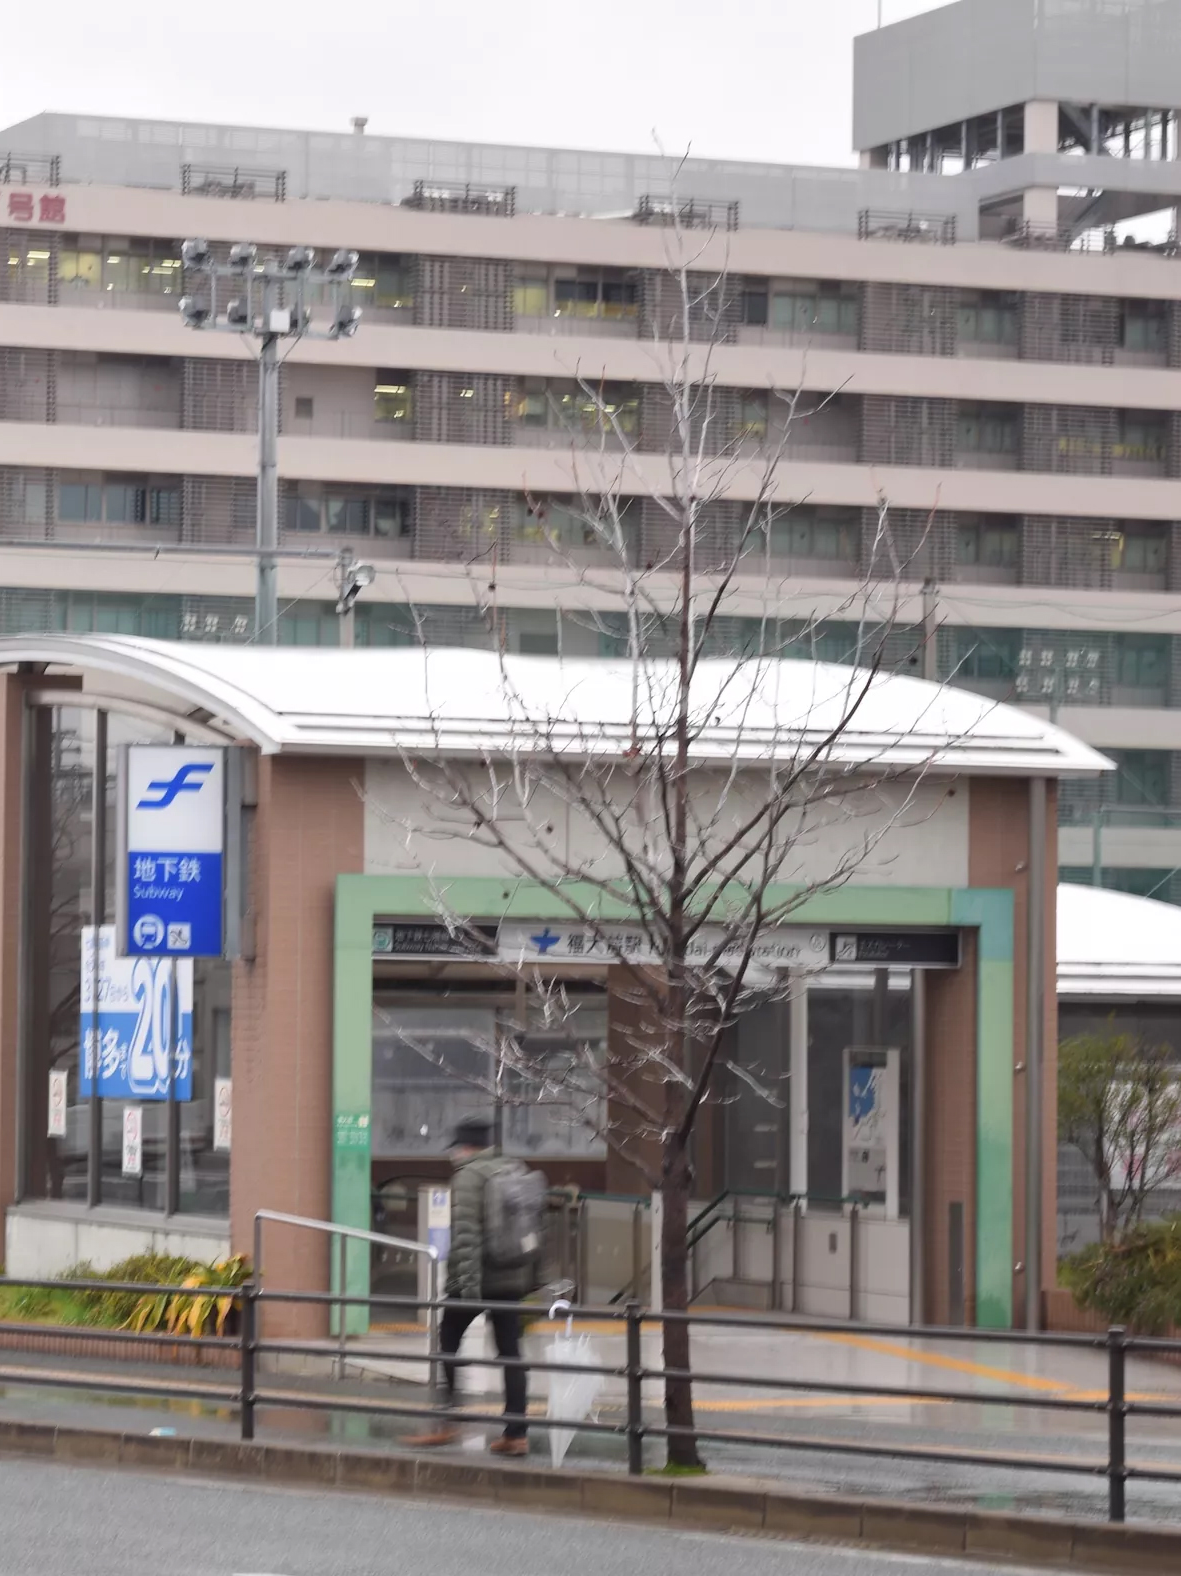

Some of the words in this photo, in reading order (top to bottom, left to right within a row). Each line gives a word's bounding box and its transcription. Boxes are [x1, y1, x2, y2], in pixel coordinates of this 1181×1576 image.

[133, 856, 202, 882] 地下鉄
[133, 883, 185, 902] Subway
